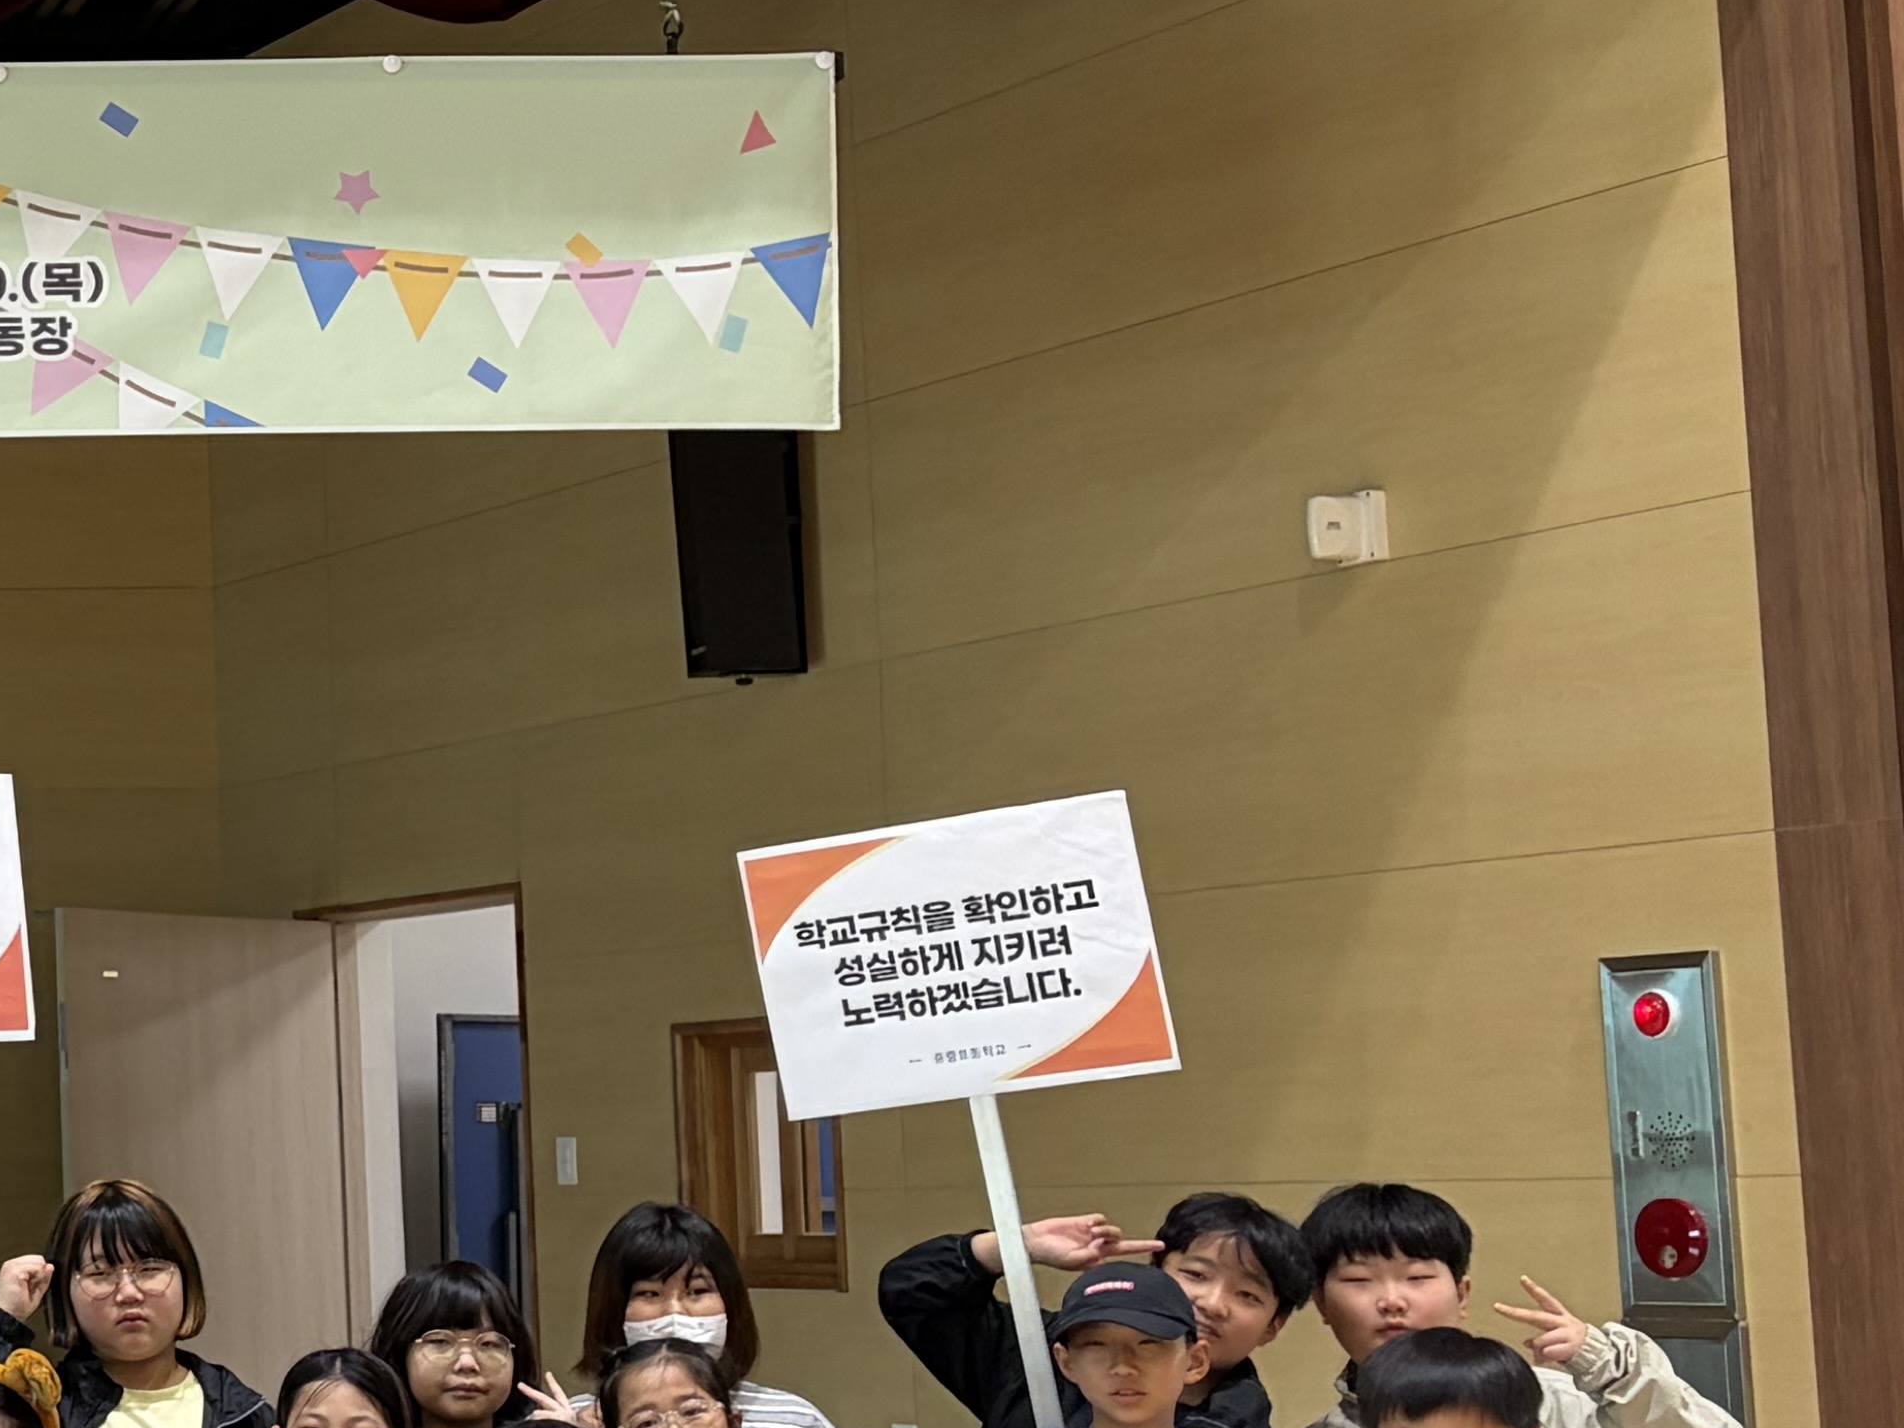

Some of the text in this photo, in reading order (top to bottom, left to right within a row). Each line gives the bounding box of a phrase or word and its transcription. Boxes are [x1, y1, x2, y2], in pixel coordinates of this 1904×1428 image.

[794, 879, 1100, 950] 학교규칙을 확인하고
[834, 925, 1073, 987] 성실하게 지키려
[842, 968, 1082, 1028] 노력하겠습니다.
